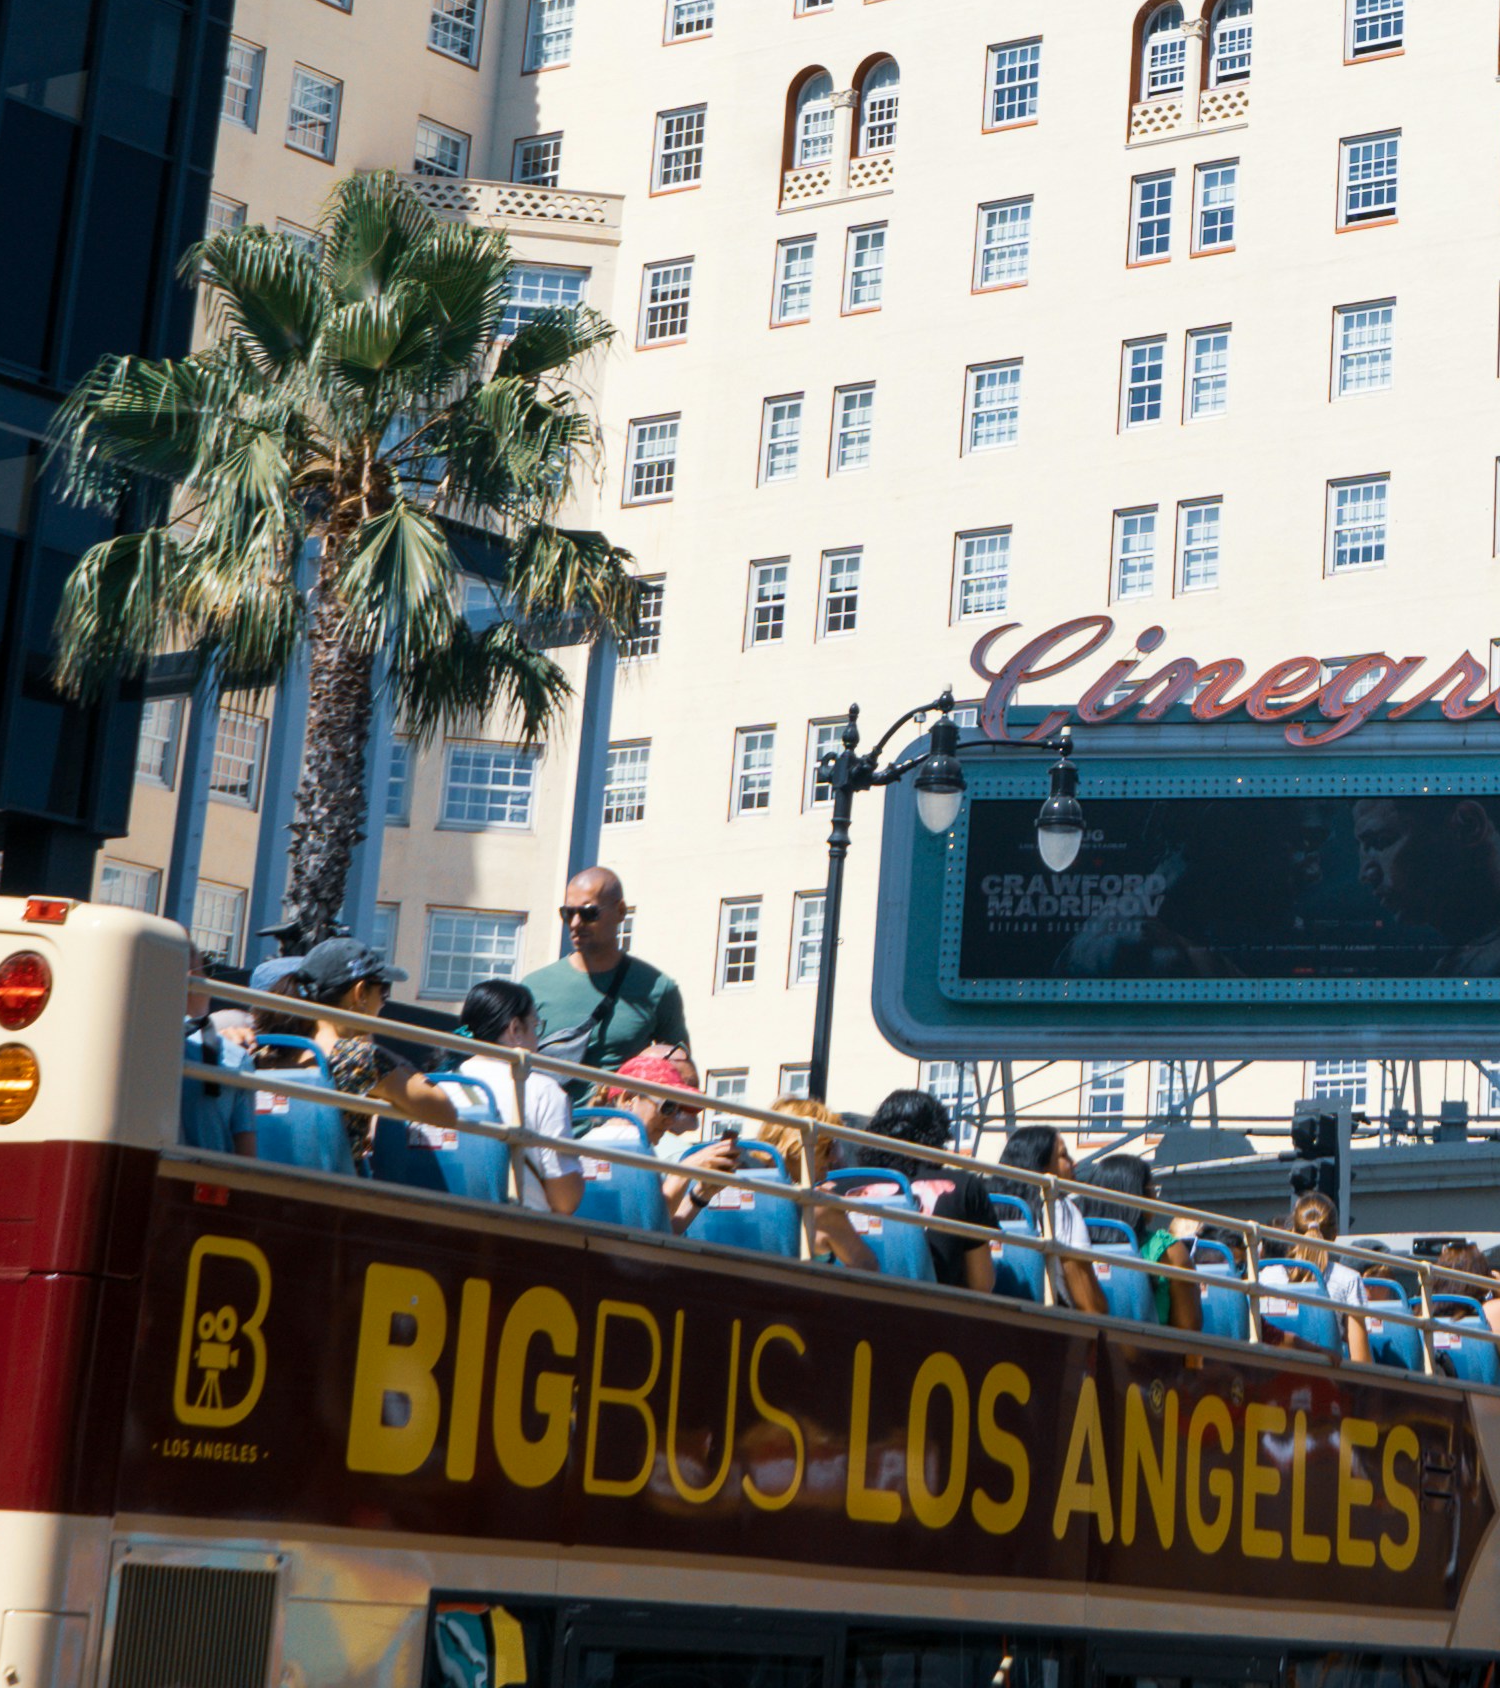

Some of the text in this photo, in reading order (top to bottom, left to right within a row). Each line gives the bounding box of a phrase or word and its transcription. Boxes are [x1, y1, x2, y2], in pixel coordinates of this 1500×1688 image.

[980, 873, 1167, 896] CRAWFORD
[986, 895, 1166, 917] MADRIMOV
[164, 1438, 259, 1463] LOS ANGELES
[846, 1339, 1031, 1535] LOS
[1053, 1376, 1421, 1573] ANGELES
